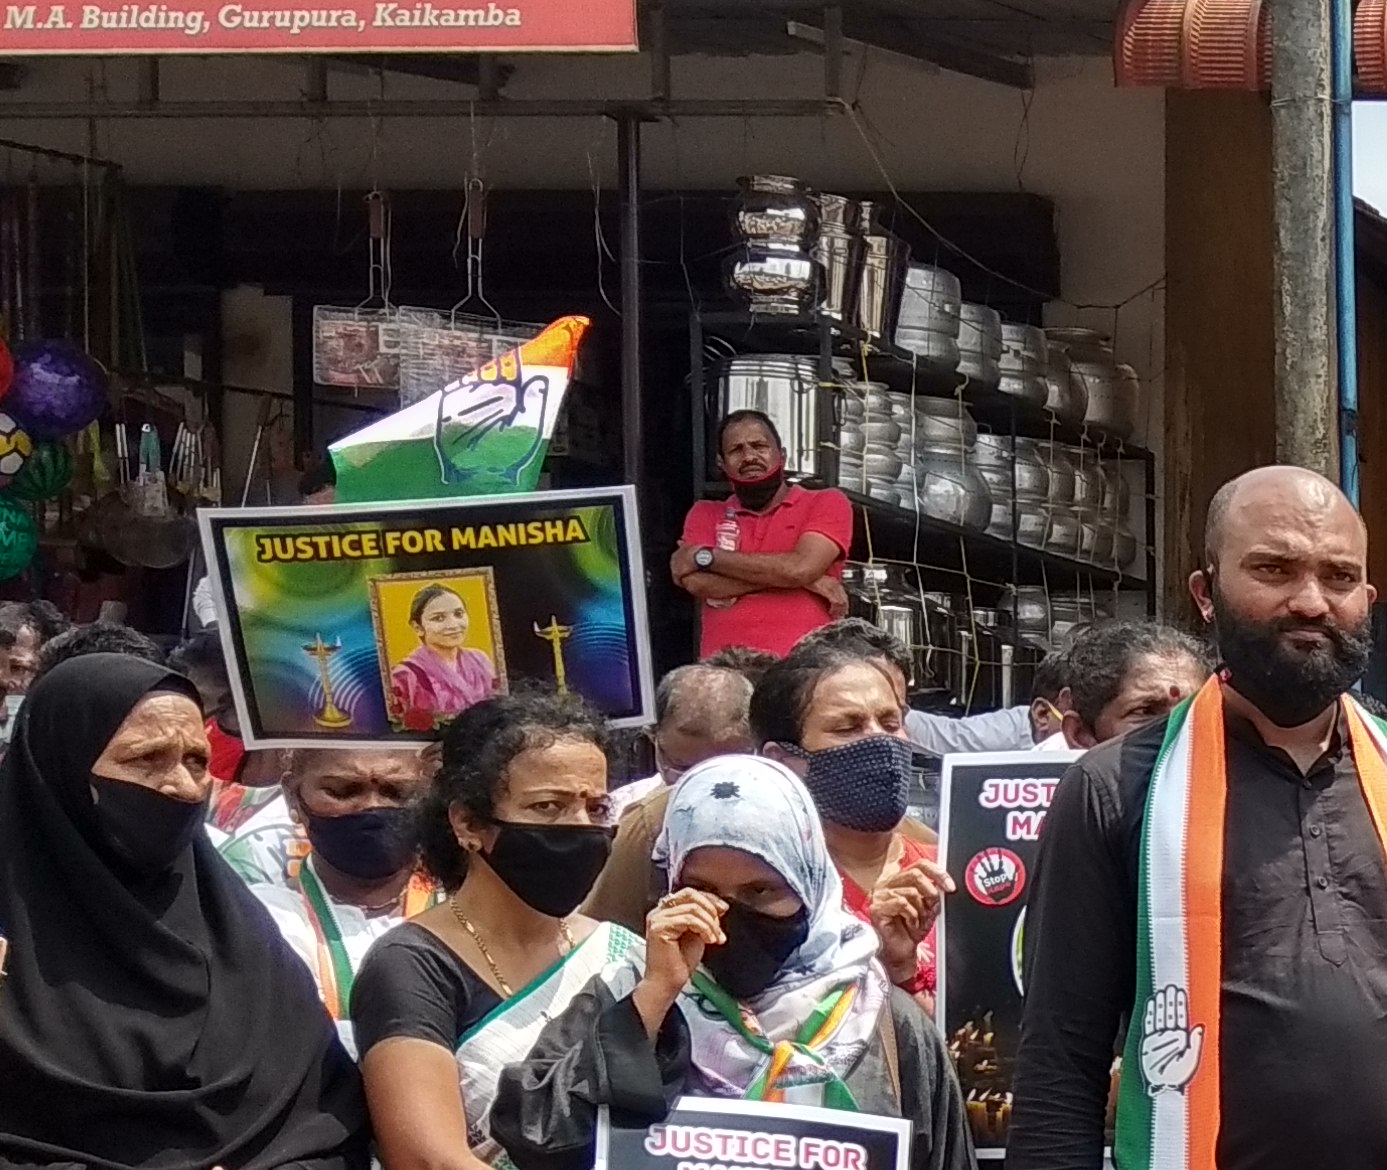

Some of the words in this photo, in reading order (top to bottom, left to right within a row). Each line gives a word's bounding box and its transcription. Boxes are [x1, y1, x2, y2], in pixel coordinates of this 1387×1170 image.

[3, 6, 73, 29] M.A.
[79, 4, 211, 34] Building,
[218, 8, 367, 33] Gurupura,
[372, 3, 522, 28] Kaikamba
[260, 534, 380, 560] JUSTICE
[386, 528, 446, 555] FOR
[452, 518, 585, 551] MANISHA
[982, 780, 1058, 805] JUST
[647, 1125, 794, 1163] JUSTICE
